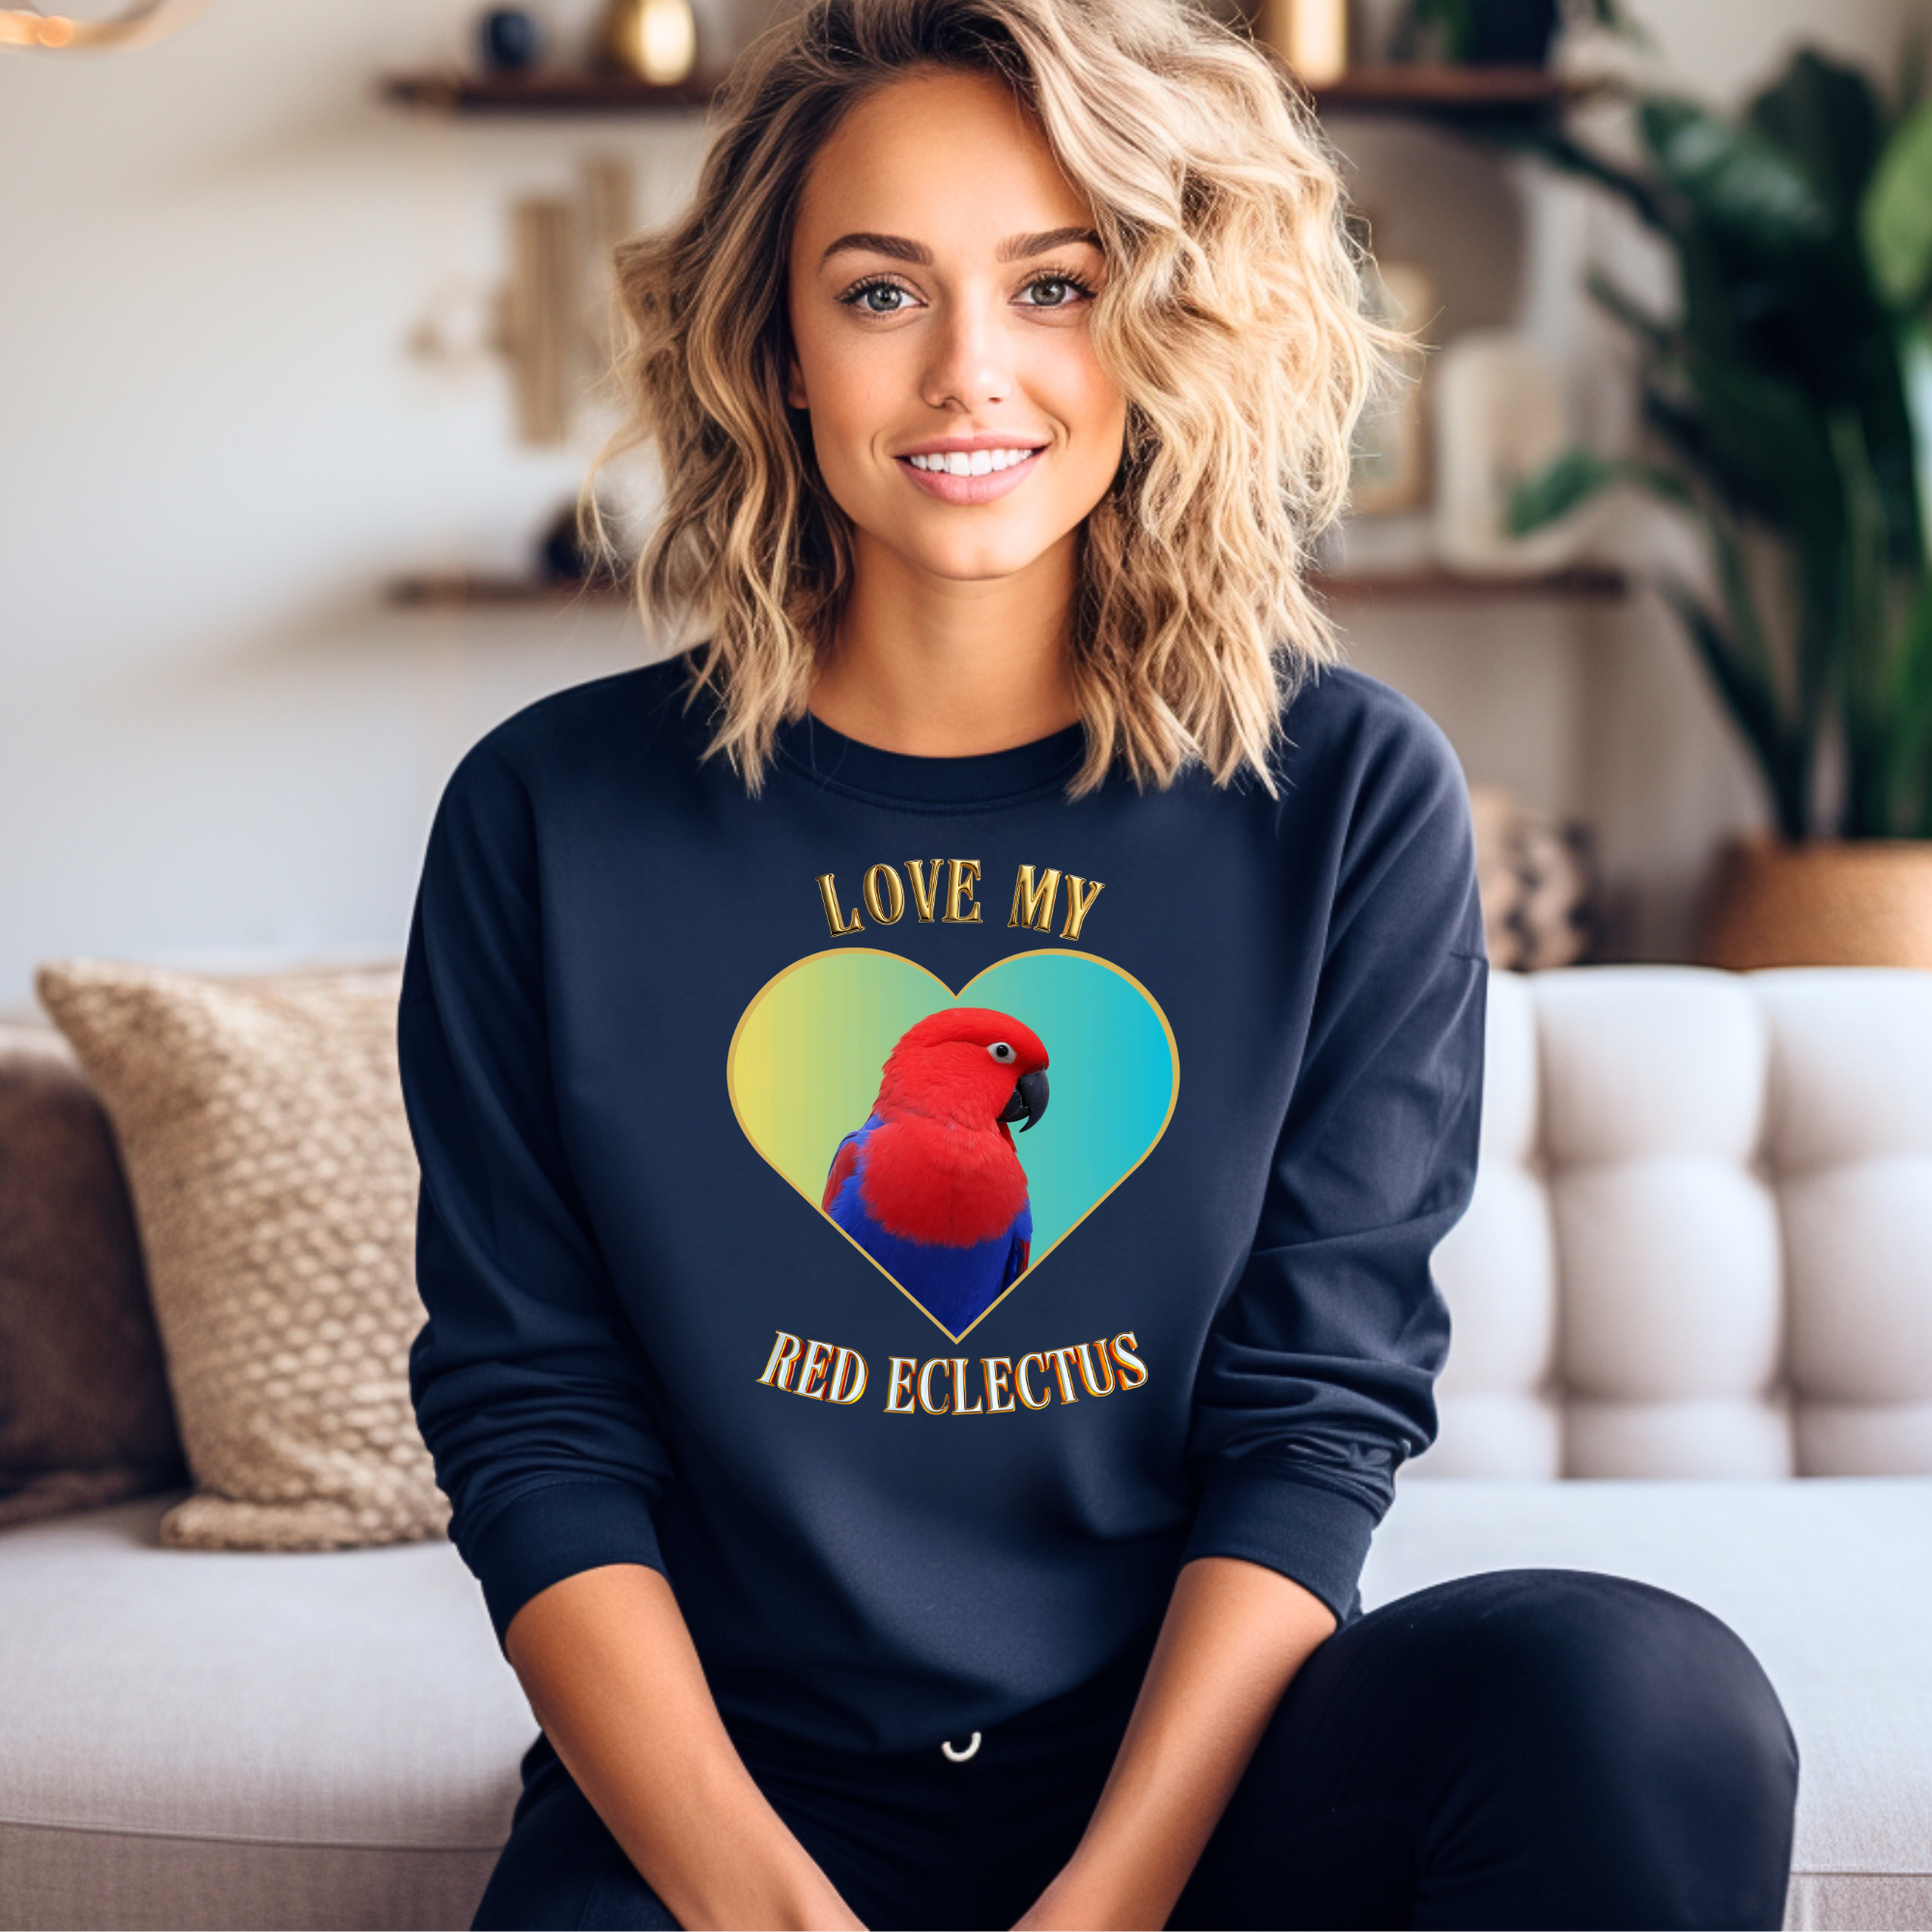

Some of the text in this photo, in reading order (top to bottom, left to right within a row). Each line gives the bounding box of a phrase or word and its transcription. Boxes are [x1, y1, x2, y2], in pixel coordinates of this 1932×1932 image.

[814, 858, 1106, 941] LOVE MY
[755, 1330, 1149, 1416] RED ECLECTUS
